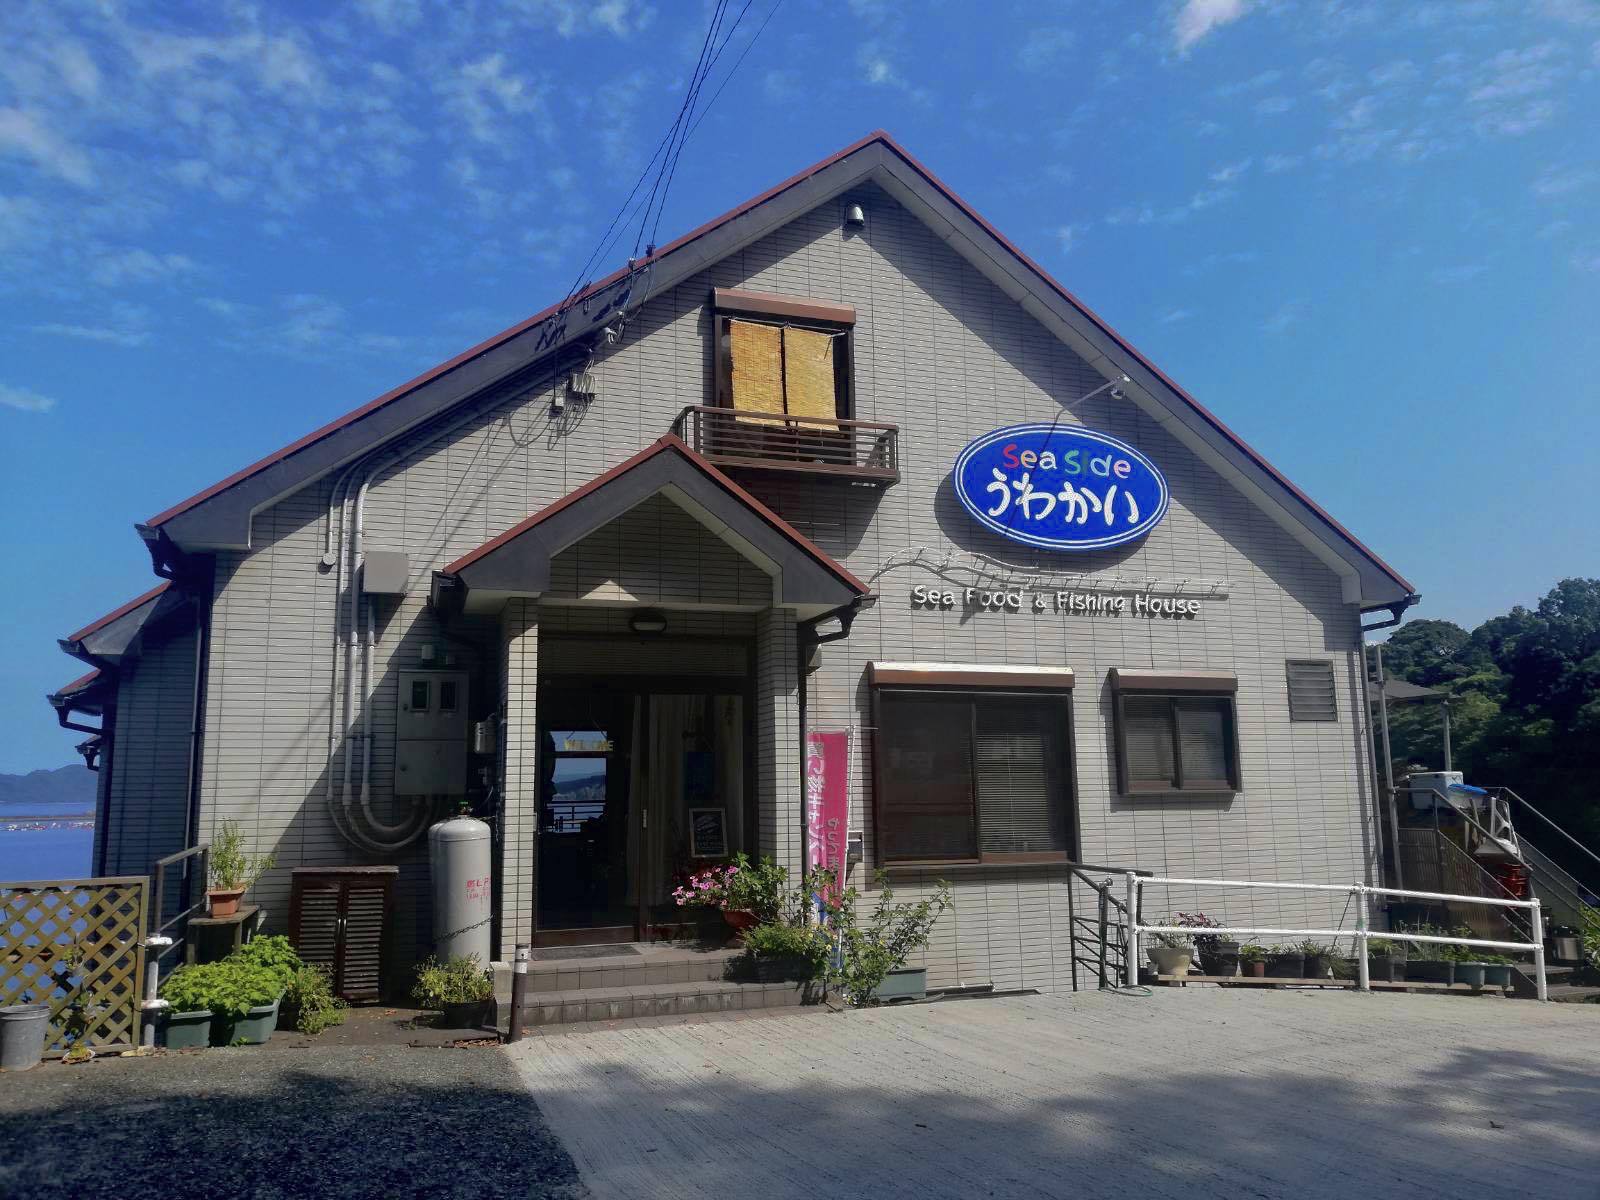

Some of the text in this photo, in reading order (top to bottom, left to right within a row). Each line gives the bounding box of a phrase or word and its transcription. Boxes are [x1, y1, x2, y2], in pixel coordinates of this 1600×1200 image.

[1003, 443, 1132, 479] Sea Side
[986, 467, 1140, 526] うわかい
[914, 584, 1201, 614] Sea Food & Fishing House
